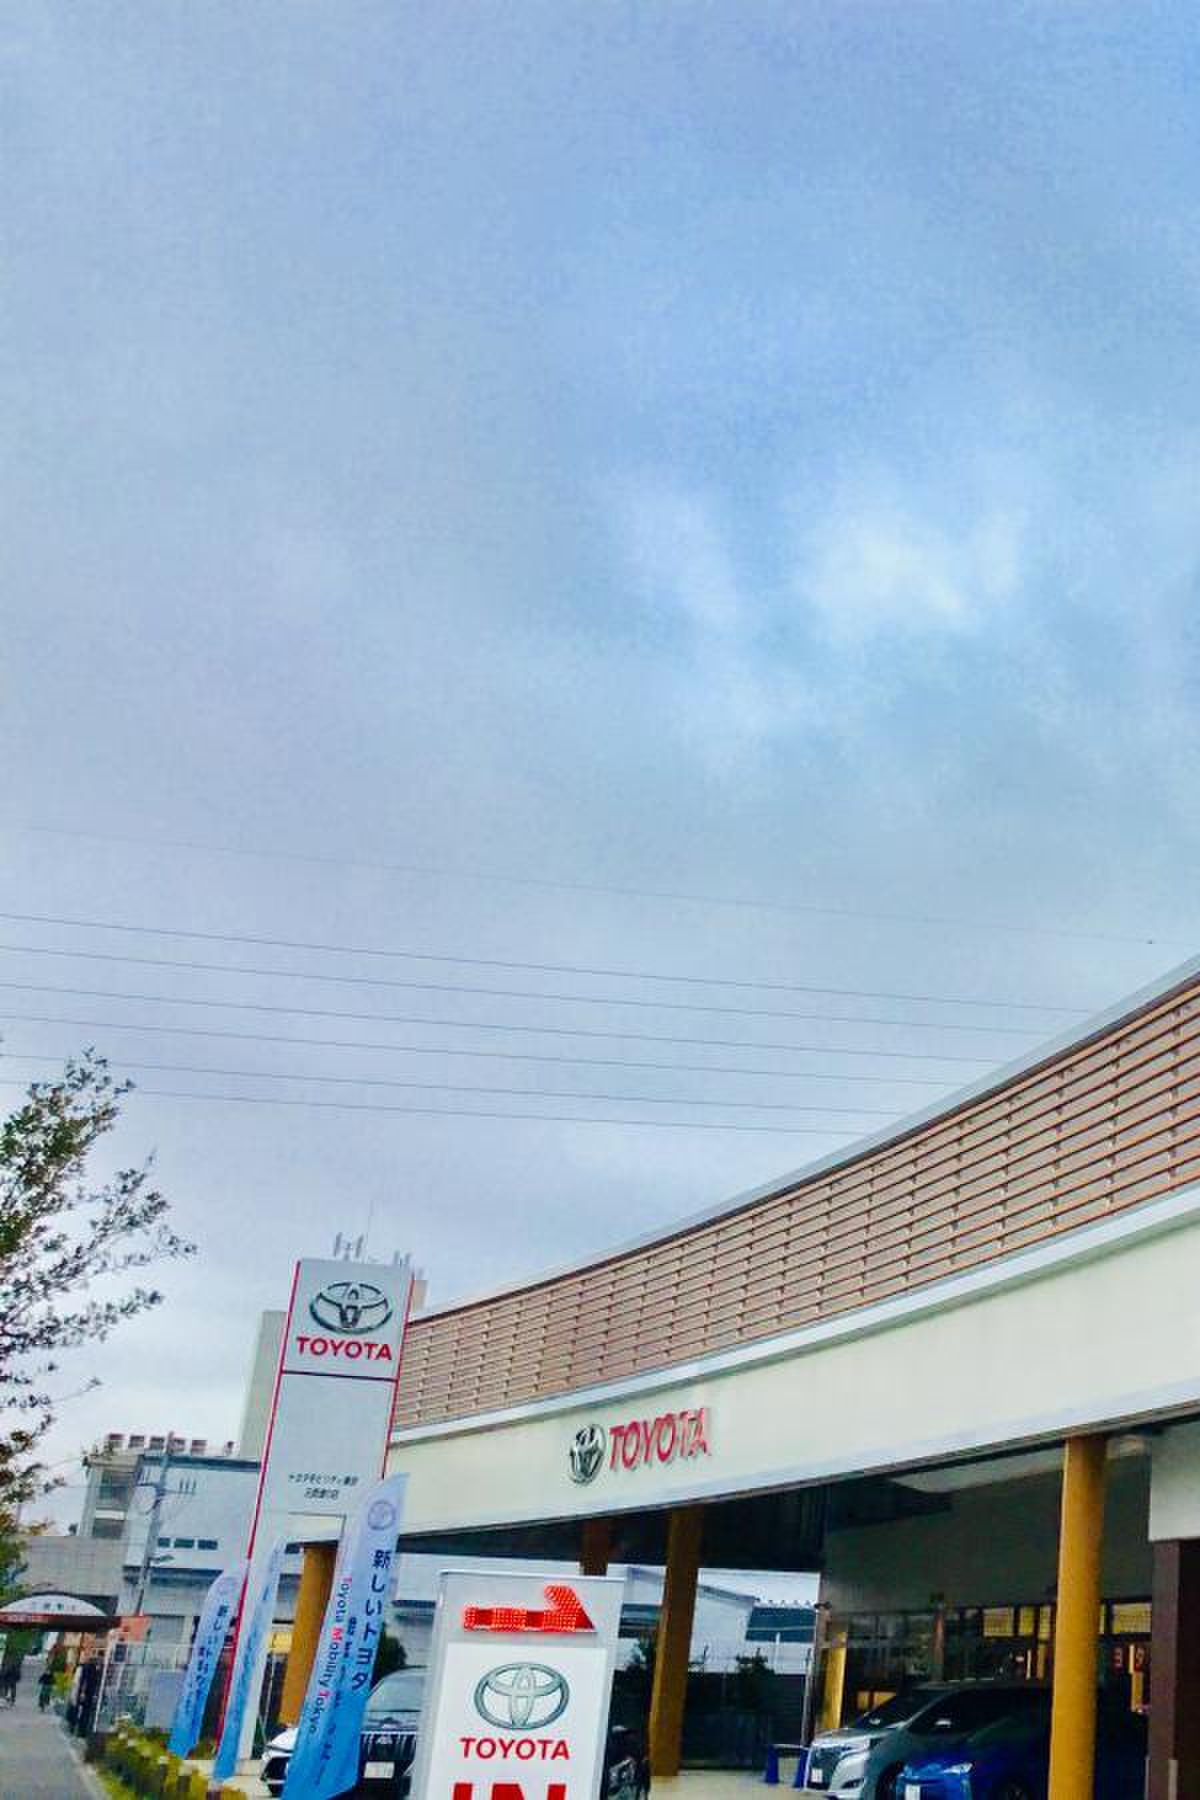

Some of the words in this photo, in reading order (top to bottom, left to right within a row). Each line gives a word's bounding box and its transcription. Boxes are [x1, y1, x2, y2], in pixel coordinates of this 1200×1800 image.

[295, 1335, 392, 1361] TOYOTA
[608, 1407, 710, 1471] TOYOTA
[459, 1737, 570, 1761] TOYOTA
